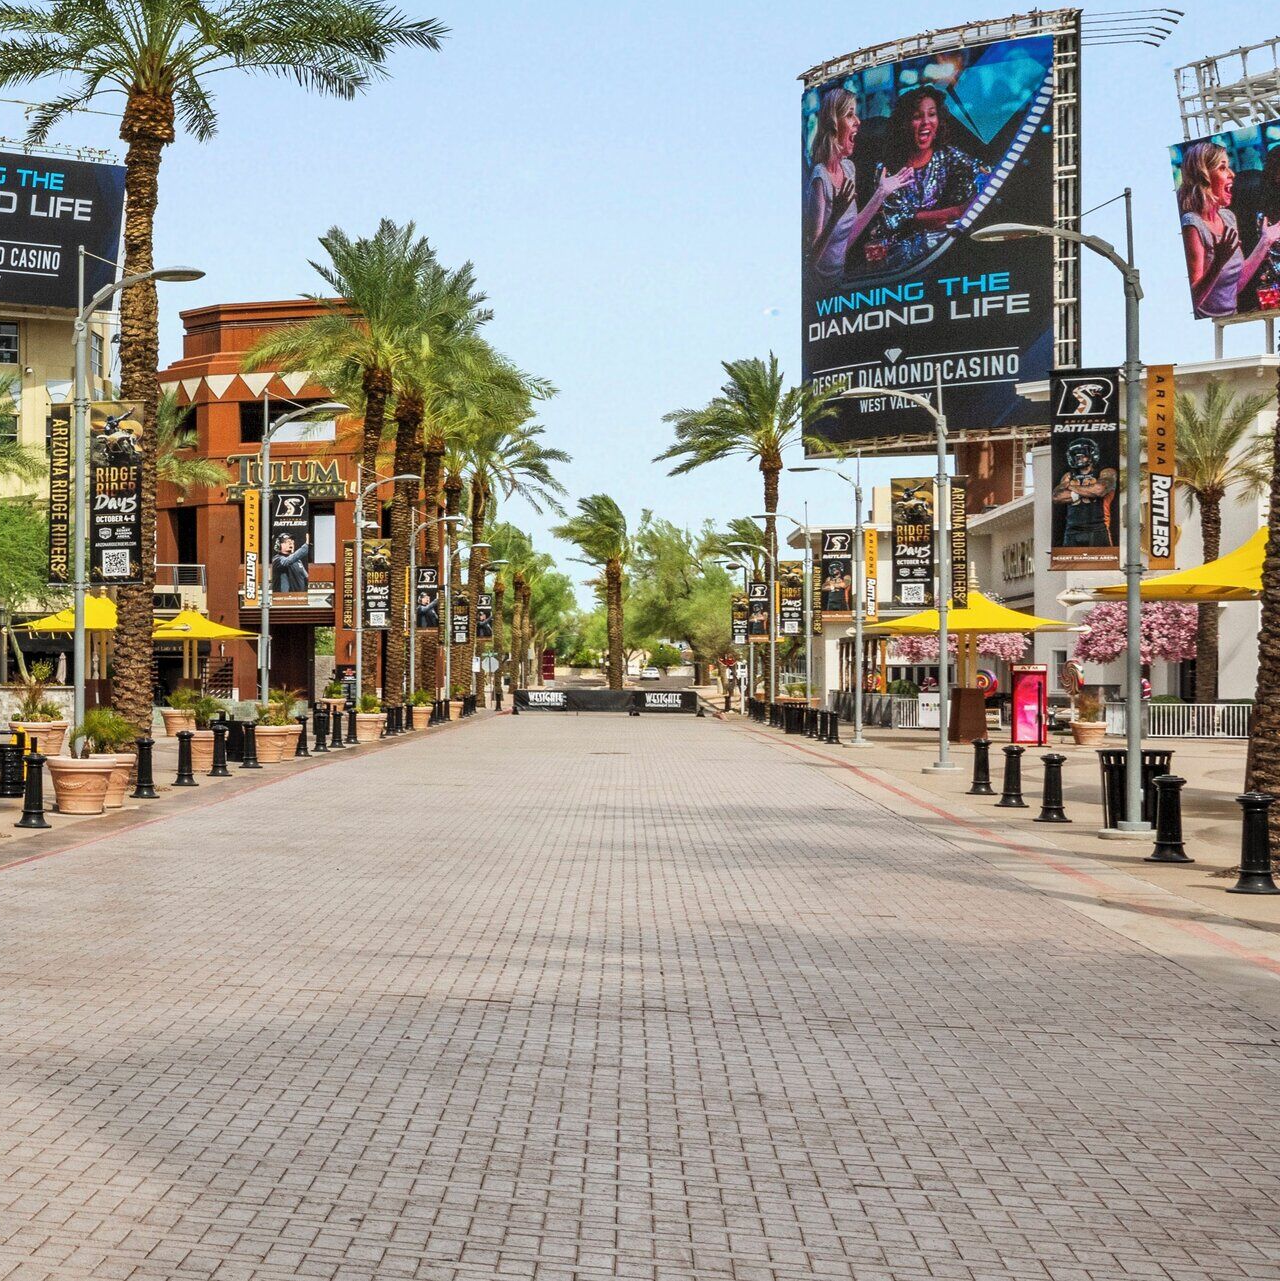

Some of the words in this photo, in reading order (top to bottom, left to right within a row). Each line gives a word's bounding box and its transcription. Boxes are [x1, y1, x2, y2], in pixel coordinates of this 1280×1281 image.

[17, 168, 65, 191] THE
[31, 192, 93, 221] LIFE
[10, 245, 61, 271] CASINO
[816, 281, 925, 317] WINNING
[938, 272, 1011, 297] THE
[809, 303, 935, 343] DIAMOND
[950, 293, 1030, 320] LIFE
[859, 361, 934, 388] DIAMOND
[942, 354, 1020, 381] CASINO
[860, 397, 887, 413] WEST
[1053, 423, 1117, 433] RATTLERS
[1156, 375, 1166, 466] ARIZONA
[51, 419, 68, 476] ARIZONA
[96, 466, 137, 482] RIDGE
[226, 452, 341, 485] TULUM
[51, 481, 68, 520] RIDGE
[952, 487, 965, 529] ARIZONA
[96, 515, 123, 523] OCTOBER
[896, 524, 930, 536] RIDGE
[1152, 475, 1172, 558] RATTLERS
[50, 523, 68, 572] RIDERS
[344, 547, 353, 577] ARIZONA
[952, 532, 965, 562] RIDGE
[246, 552, 257, 599] RATTLERS
[344, 578, 353, 594] RIDGE
[366, 571, 389, 580] RIDGE
[953, 563, 966, 599] RIDERS
[152, 595, 181, 608] OLA
[866, 579, 876, 616] RATTLERS
[528, 692, 564, 703] WESTGATE
[645, 692, 682, 704] WESTGATE
